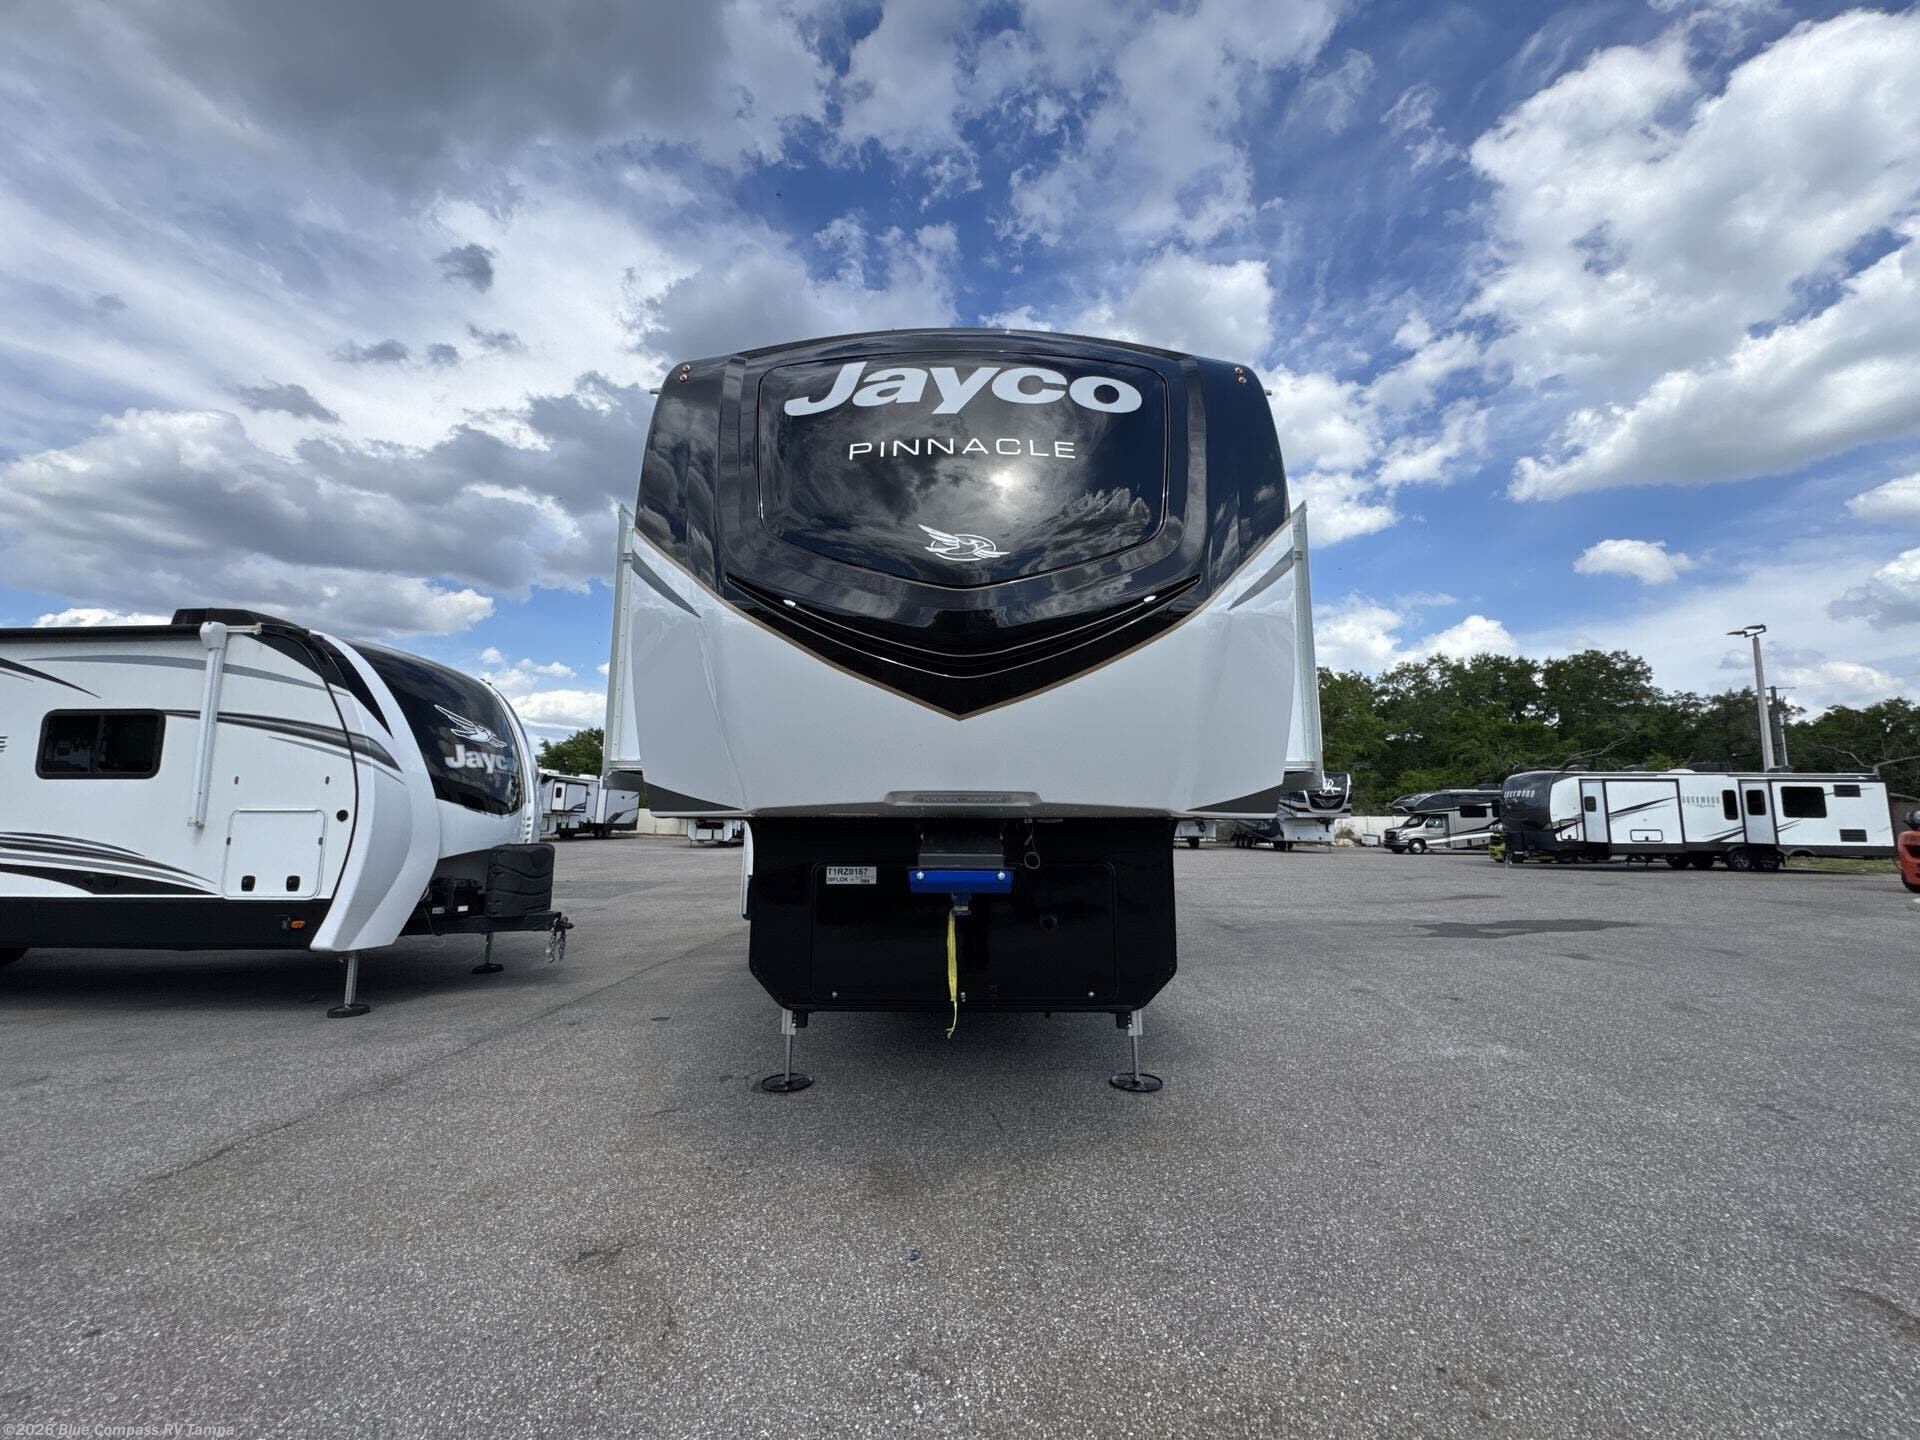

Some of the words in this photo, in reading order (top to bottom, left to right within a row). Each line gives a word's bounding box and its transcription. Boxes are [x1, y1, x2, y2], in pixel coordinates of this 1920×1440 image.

[784, 361, 1142, 417] Jayco
[848, 438, 1076, 461] PINNACLE
[827, 867, 869, 876] T1RZ0167
